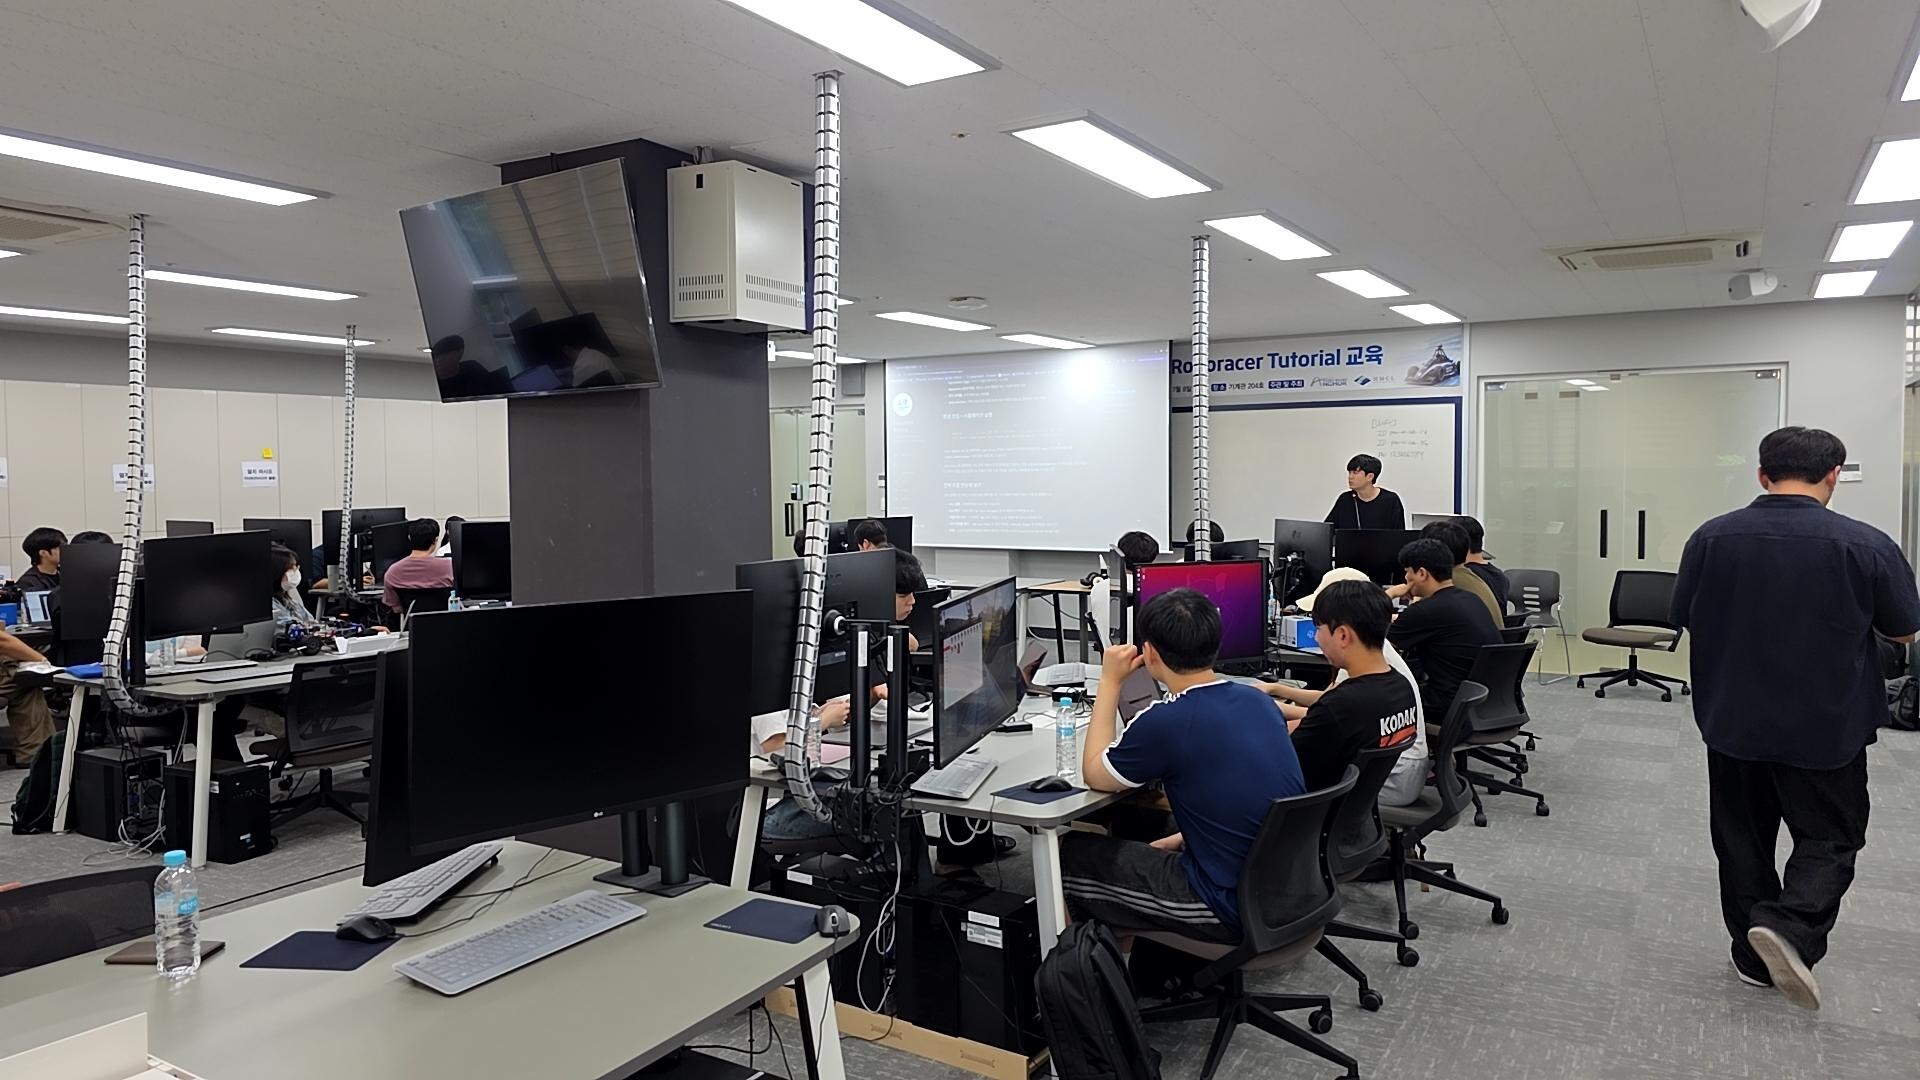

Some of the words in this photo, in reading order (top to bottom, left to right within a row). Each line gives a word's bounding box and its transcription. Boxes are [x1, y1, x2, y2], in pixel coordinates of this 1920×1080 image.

[1171, 357, 1263, 375] Rooracer
[1267, 350, 1340, 369] Tutorial
[1346, 345, 1383, 365] 교육
[1380, 706, 1416, 736] KODAK
